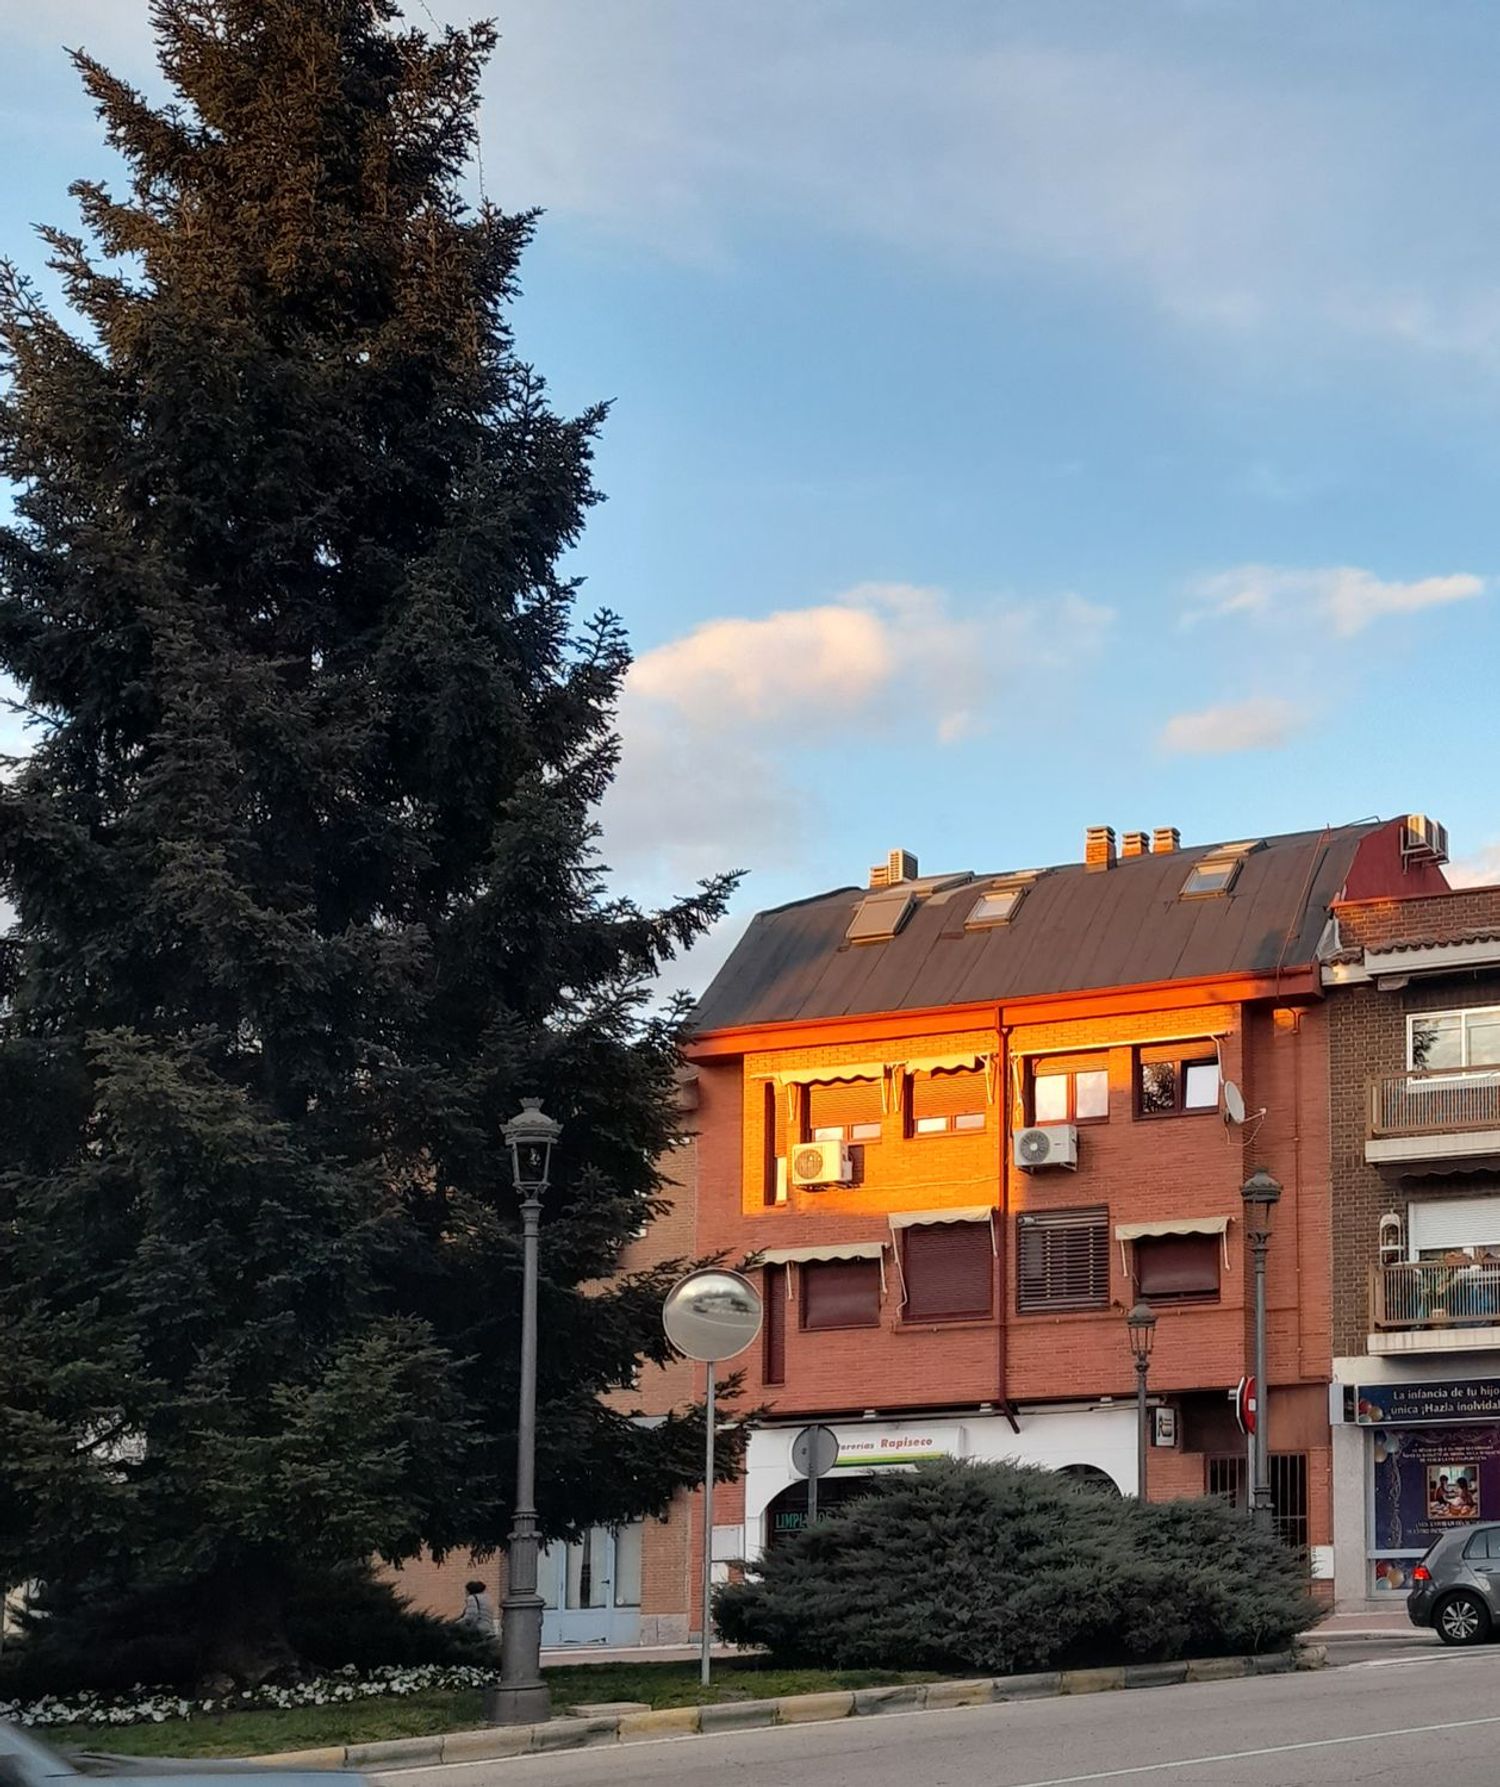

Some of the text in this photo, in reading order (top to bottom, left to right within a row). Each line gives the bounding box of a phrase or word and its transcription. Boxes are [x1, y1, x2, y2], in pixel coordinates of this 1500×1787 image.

[1393, 1391, 1405, 1400] La
[1451, 1387, 1464, 1397] de
[1467, 1387, 1477, 1397] tu
[1480, 1386, 1499, 1398] hijo
[880, 1436, 933, 1450] Rapiseco
